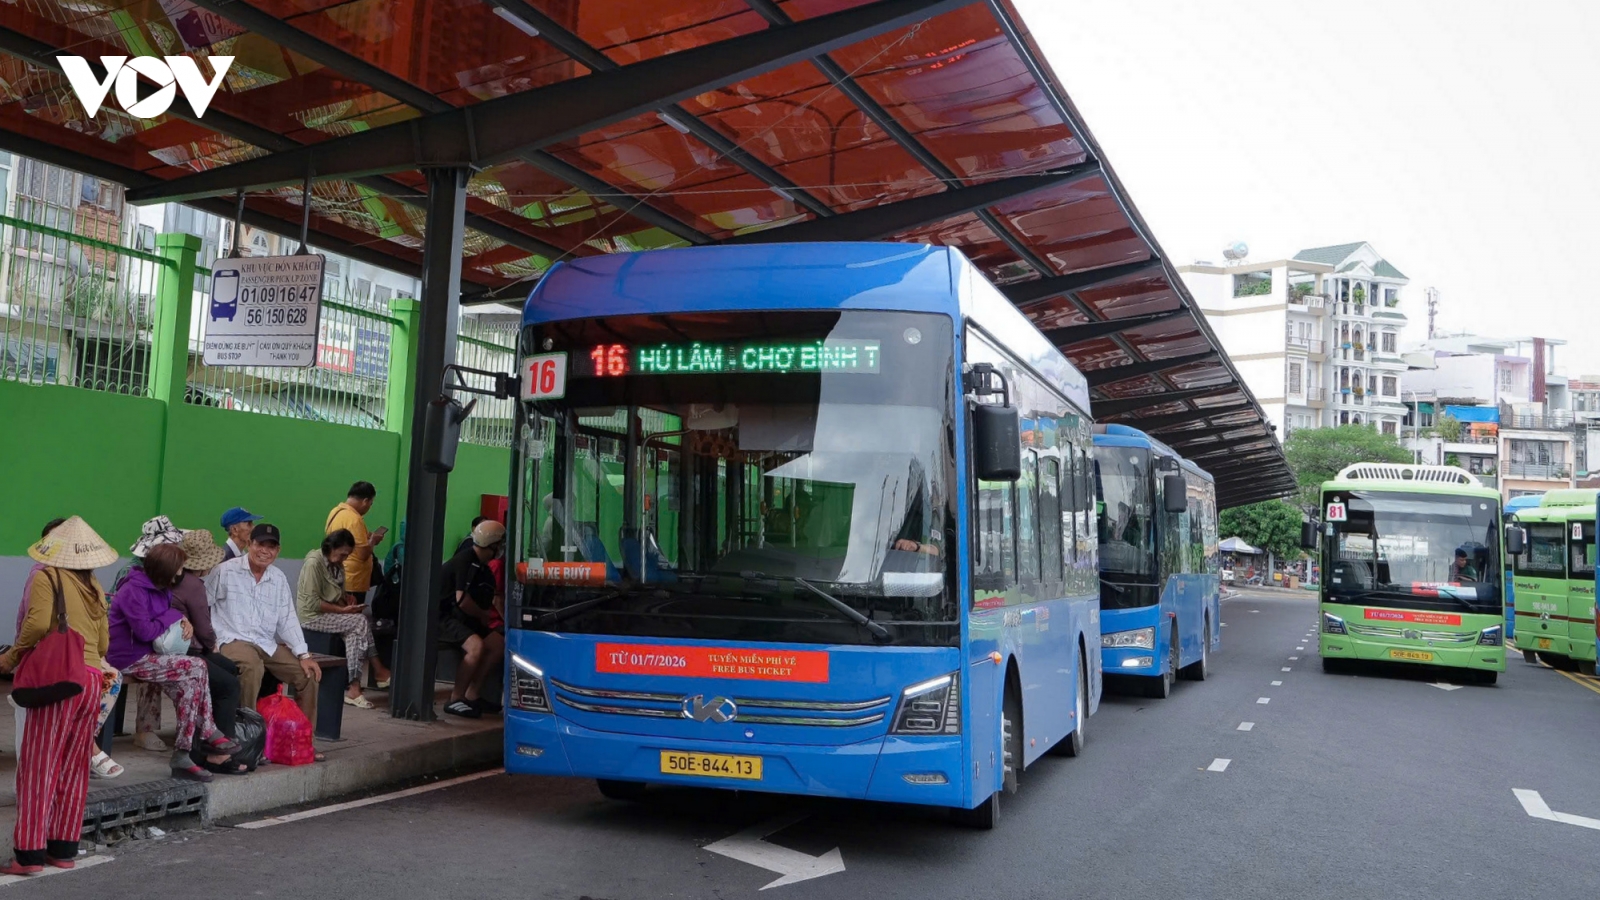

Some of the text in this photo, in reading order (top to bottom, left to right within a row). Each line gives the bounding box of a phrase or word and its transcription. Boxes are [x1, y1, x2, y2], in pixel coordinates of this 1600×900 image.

[241, 263, 255, 273] KHU
[275, 260, 291, 272] ĐÓN
[292, 259, 320, 271] KHÁCH
[241, 286, 316, 303] 01 09 16 47
[247, 308, 307, 324] 56 150 628
[217, 352, 242, 360] BUS STOP
[270, 353, 300, 361] THANK YOU
[591, 345, 625, 376] 16
[640, 343, 671, 371] HÚ
[678, 343, 722, 371] LÂM
[742, 347, 795, 373] CHỢ
[801, 340, 857, 369] BÌNH
[864, 346, 879, 368] T
[530, 360, 556, 394] 16
[1329, 505, 1343, 518] 81
[547, 567, 560, 580] XE
[563, 564, 591, 580] BUÝT
[610, 650, 628, 665] TỪ
[630, 653, 686, 667] 01/7/2026
[708, 652, 738, 664] TUYẾN
[766, 655, 782, 665] PHÍ
[712, 665, 792, 676] FREE BUS TICKET
[669, 756, 753, 775] 50E-844.13
